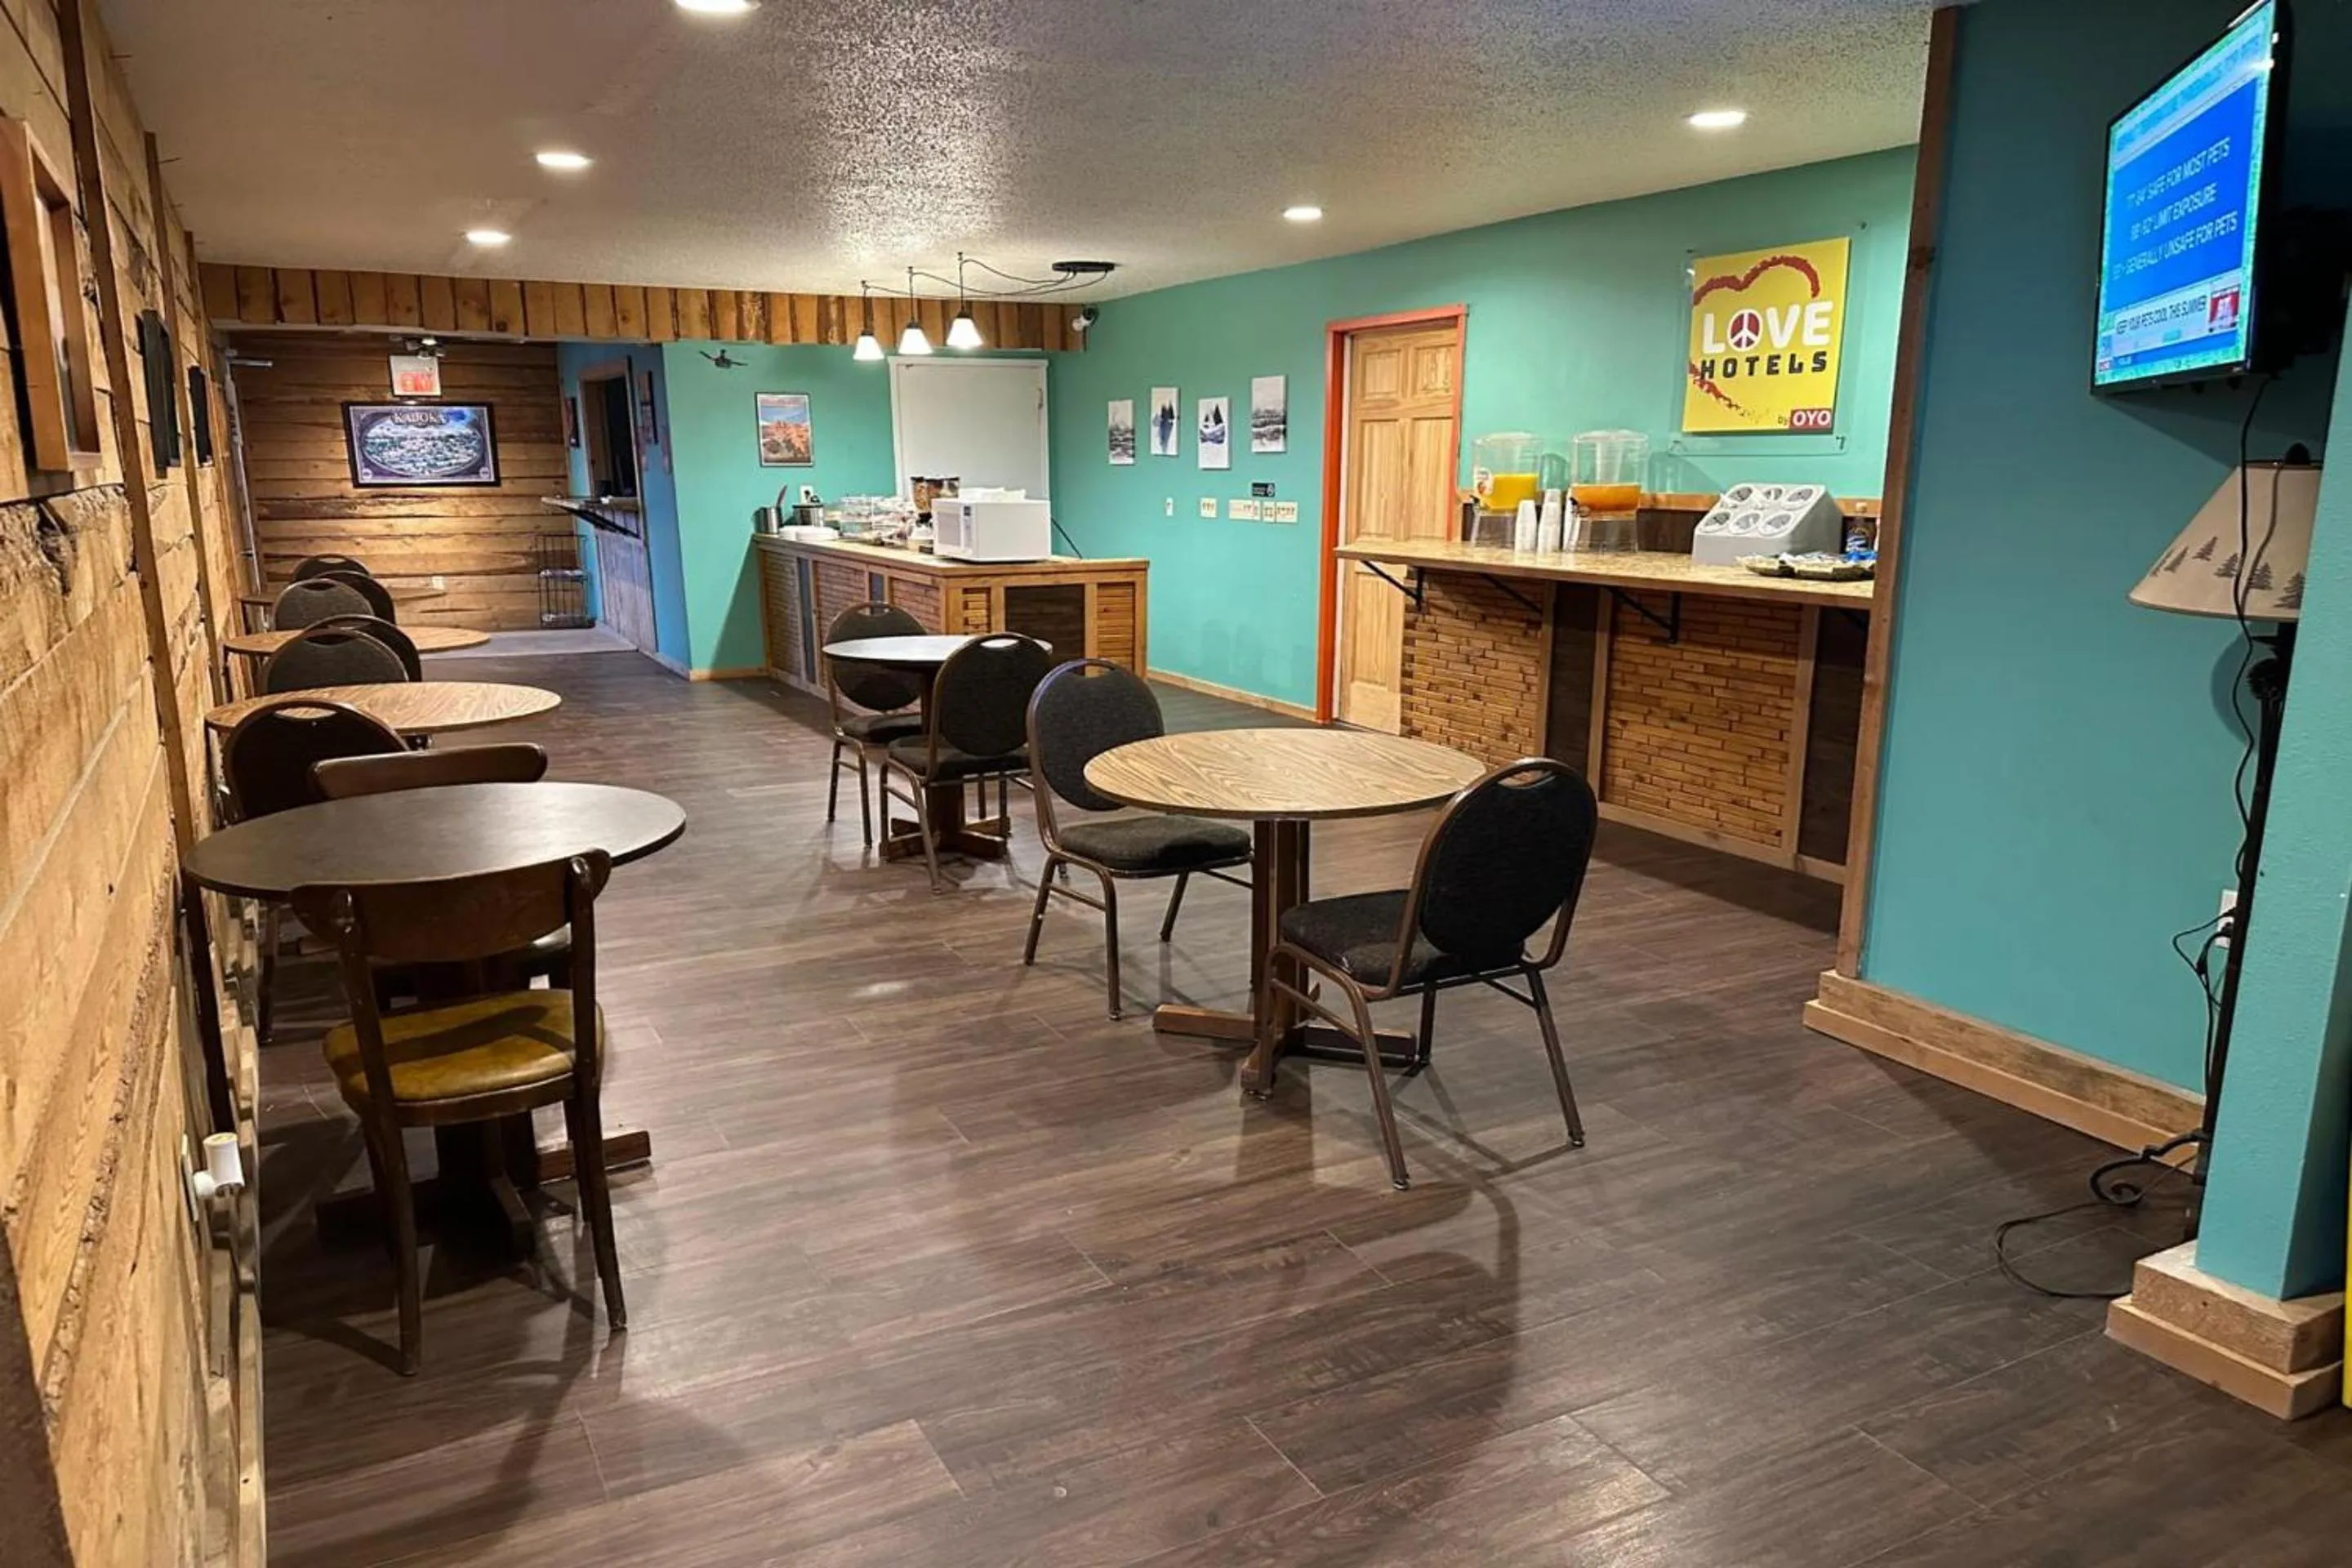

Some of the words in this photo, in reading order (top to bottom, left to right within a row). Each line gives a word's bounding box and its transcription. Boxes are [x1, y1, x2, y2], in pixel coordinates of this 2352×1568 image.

[2167, 166, 2181, 189] FOR
[2182, 150, 2206, 180] MOST
[2207, 136, 2230, 166] PETS
[2173, 182, 2217, 220] EXPOSURE
[2195, 221, 2214, 244] FOR
[2214, 211, 2238, 236] PETS
[1704, 301, 1833, 353] LOVE
[1700, 351, 1828, 380] HOTELS
[1793, 410, 1831, 425] OYO
